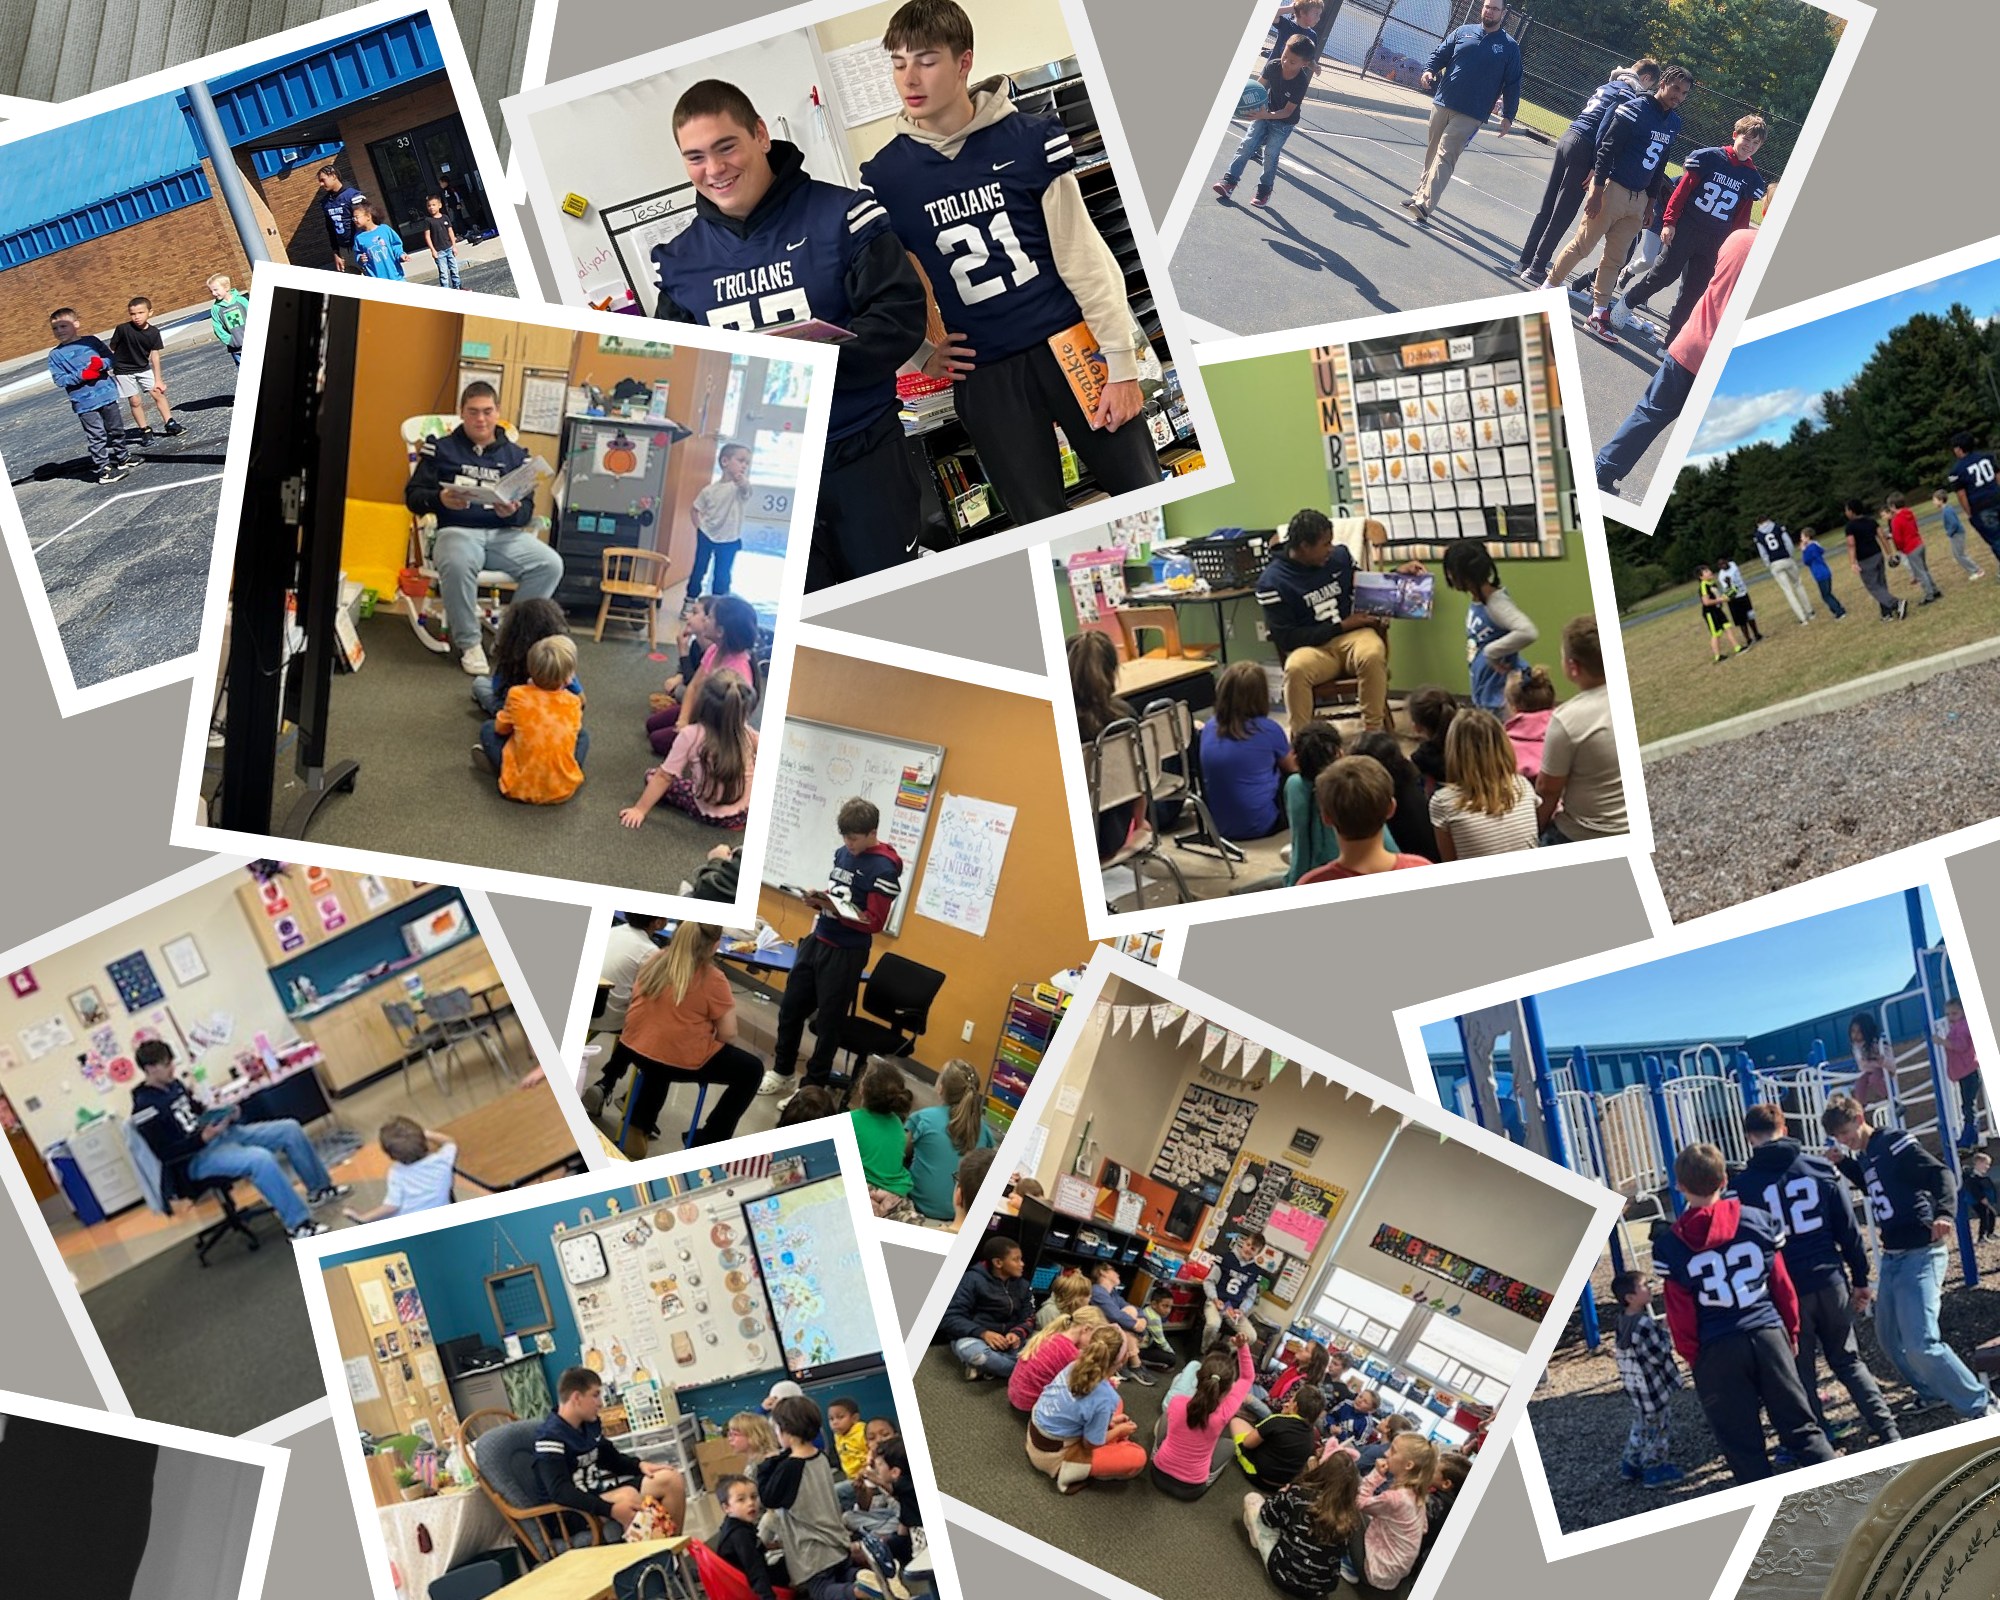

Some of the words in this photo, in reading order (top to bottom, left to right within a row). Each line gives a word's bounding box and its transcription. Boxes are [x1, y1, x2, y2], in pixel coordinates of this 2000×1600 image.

[396, 137, 410, 149] 33
[1649, 130, 1671, 145] TROJANS
[1641, 140, 1664, 171] 5
[1712, 171, 1742, 191] TROJANS
[622, 199, 675, 223] Tessa
[924, 181, 1006, 227] TROJANS
[1694, 181, 1739, 222] 32
[934, 210, 1040, 307] 21
[712, 260, 794, 302] TROJANS
[1452, 342, 1472, 356] 2024
[460, 463, 500, 482] TROJANS
[1967, 458, 1995, 488] 70
[762, 494, 788, 513] 39
[1764, 533, 1780, 551] 6
[1303, 581, 1343, 608] TROJANS
[1290, 1193, 1325, 1213] 2024
[1763, 1176, 1823, 1237] 12
[1406, 1238, 1526, 1299] BELIEVE
[1686, 1240, 1768, 1309] 32
[1226, 1278, 1243, 1295] 6
